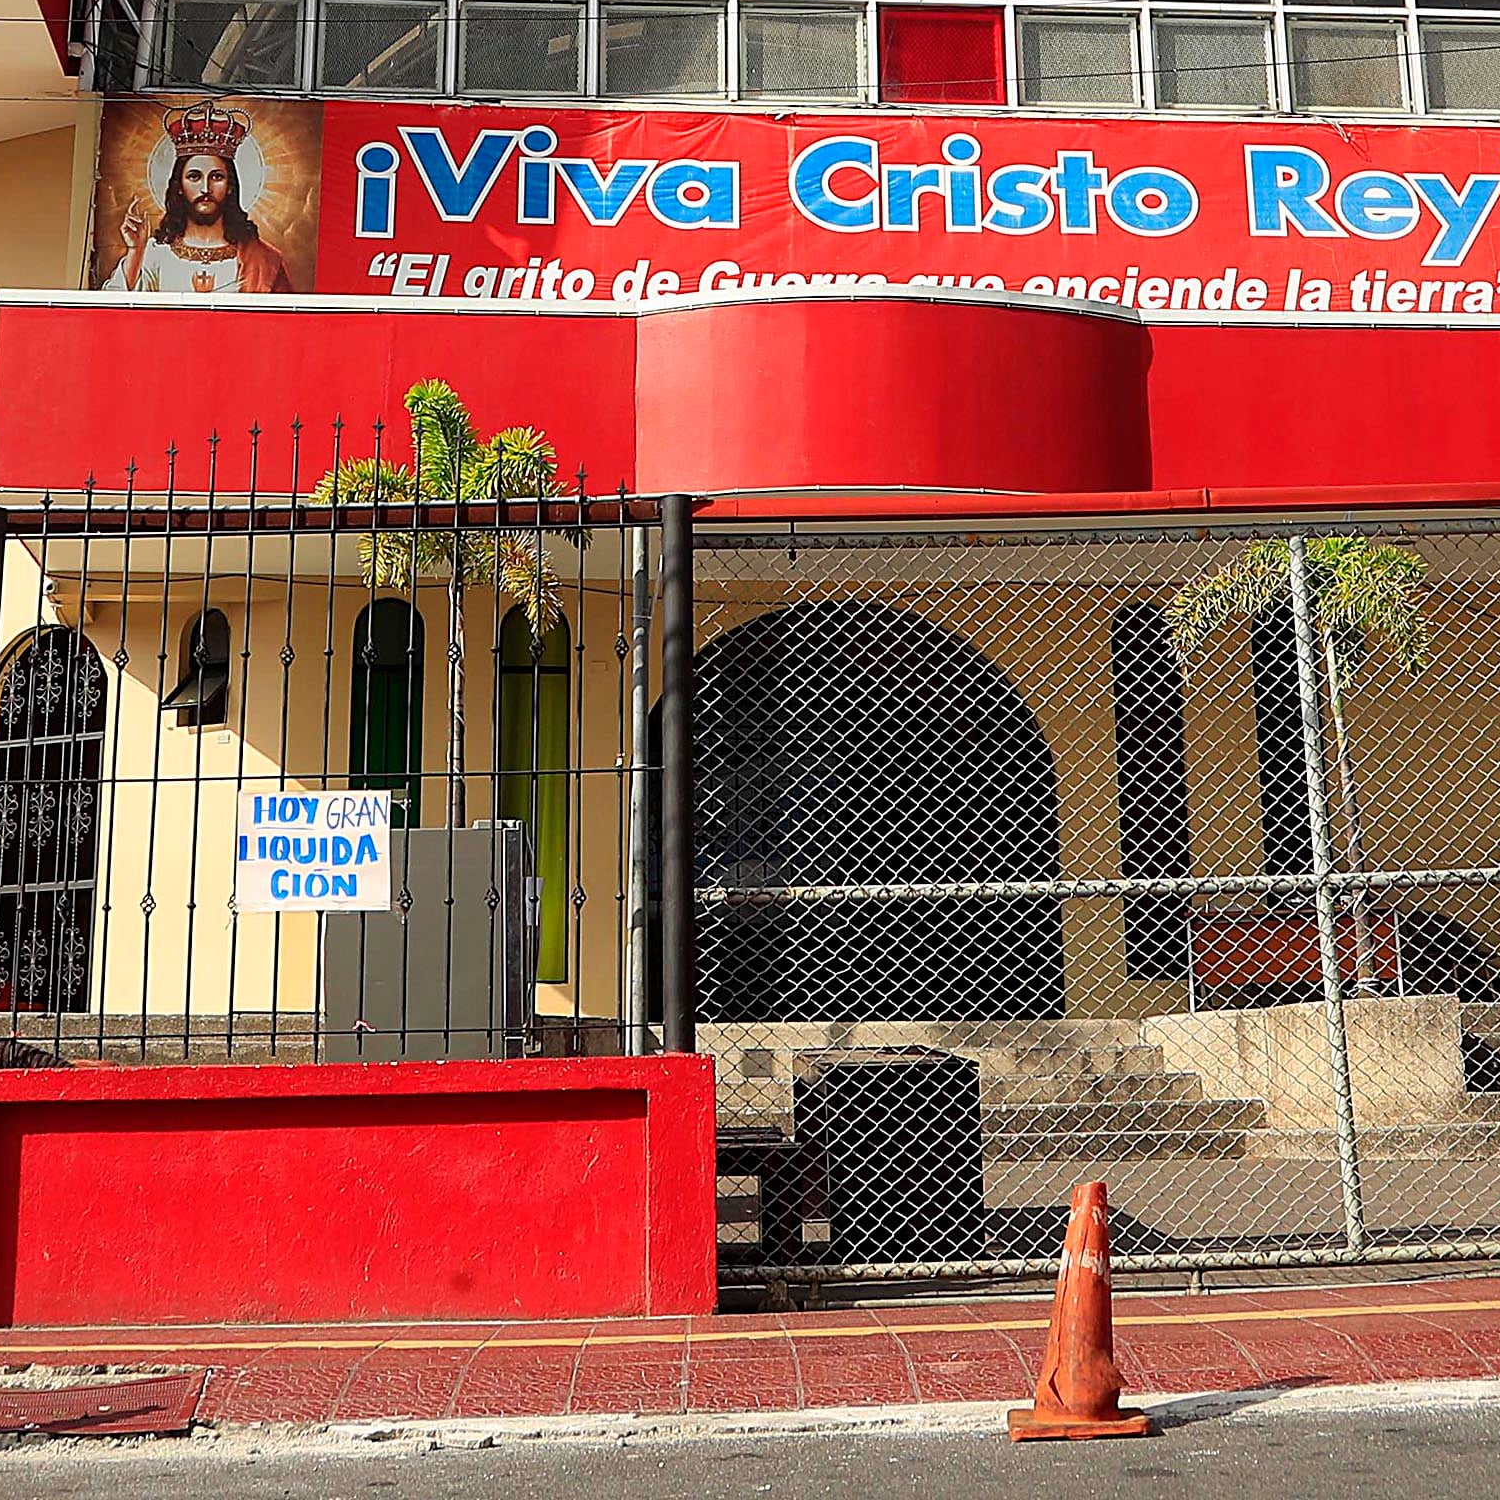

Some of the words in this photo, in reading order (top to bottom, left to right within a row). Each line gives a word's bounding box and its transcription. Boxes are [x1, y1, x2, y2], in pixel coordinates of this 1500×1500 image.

[354, 125, 740, 239] ¡Viva
[789, 132, 1198, 237] Cristo
[463, 257, 596, 300] grito
[612, 259, 680, 301] de
[1283, 268, 1332, 311] la
[253, 796, 319, 824] HOY
[326, 796, 389, 829] GRAN
[238, 833, 380, 865] LIQUIDA
